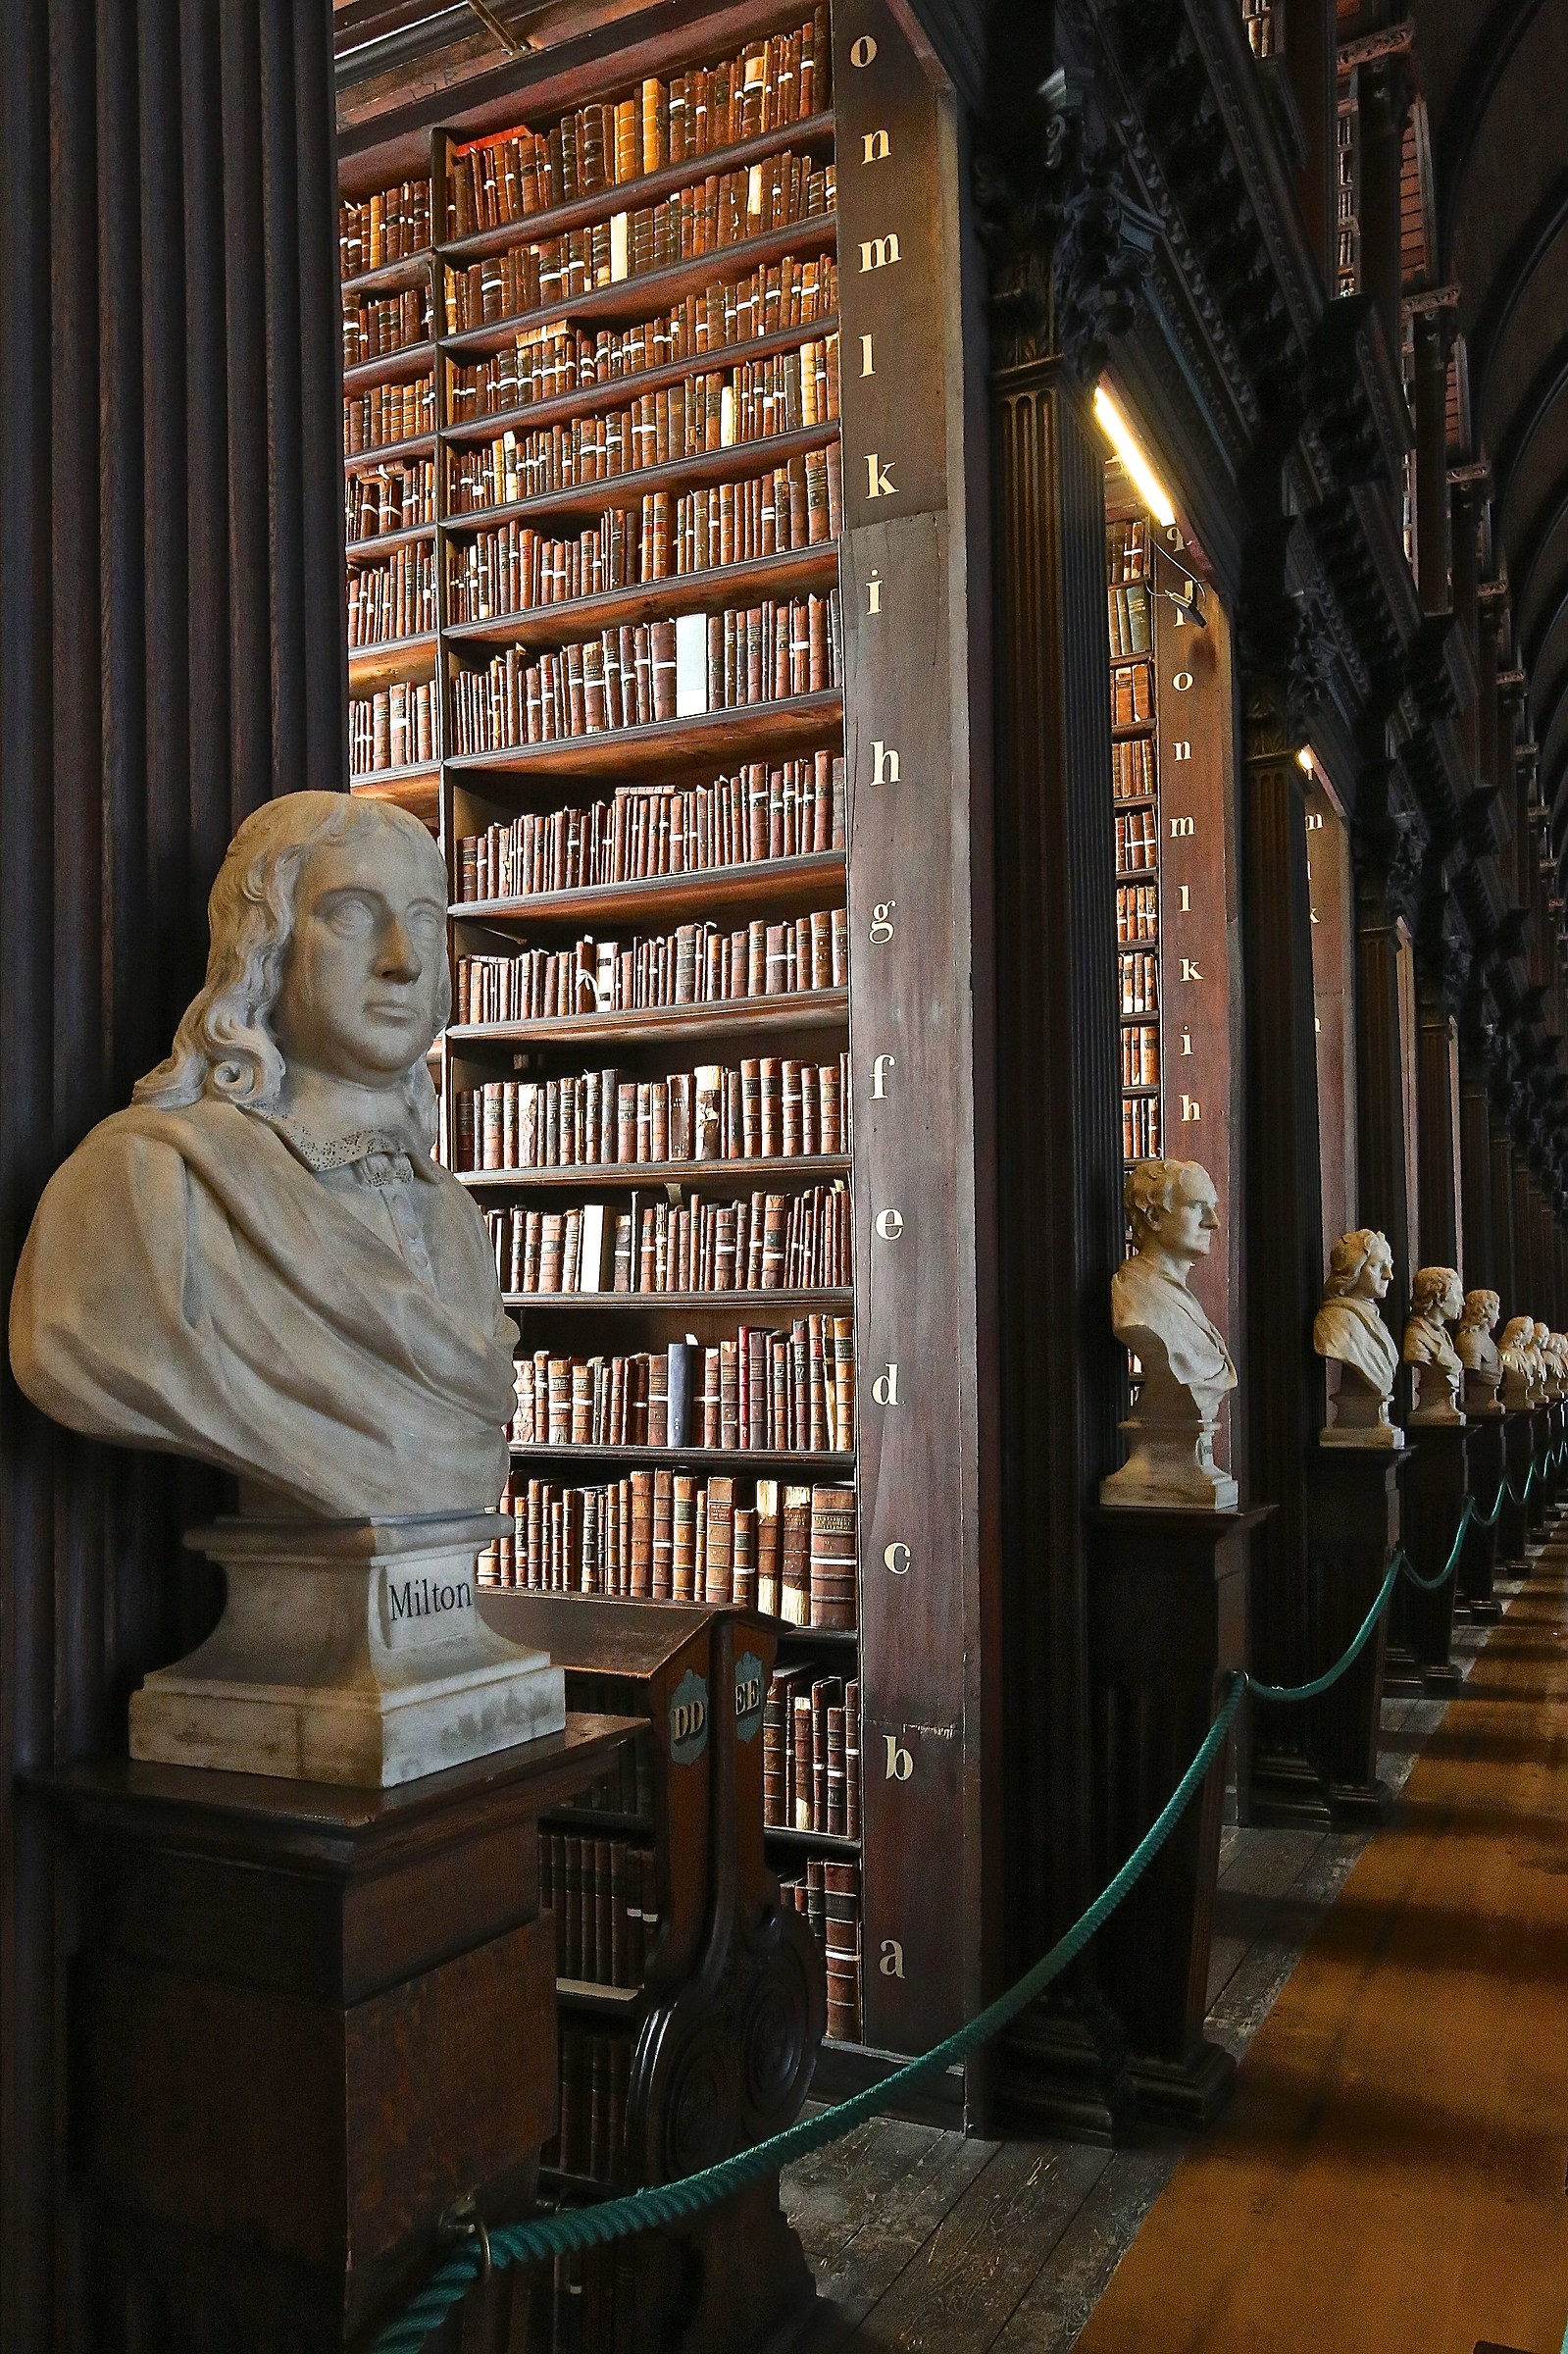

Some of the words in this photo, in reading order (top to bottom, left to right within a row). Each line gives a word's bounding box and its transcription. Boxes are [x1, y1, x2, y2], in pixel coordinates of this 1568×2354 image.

[850, 35, 878, 68] o
[861, 129, 892, 165] n
[857, 233, 902, 274] m
[863, 453, 900, 499] k
[865, 569, 884, 615] i
[1172, 672, 1193, 691] o
[869, 741, 901, 787] h
[1172, 741, 1192, 761] n
[1169, 816, 1195, 838] m
[869, 899, 896, 945] g
[1179, 958, 1204, 982] k
[1180, 1026, 1194, 1056] i
[869, 1053, 896, 1100] f
[1179, 1094, 1201, 1122] h
[875, 1207, 904, 1241] e
[872, 1362, 899, 1406] d
[884, 1542, 911, 1575] c
[388, 1578, 474, 1621] Milton
[734, 1678, 760, 1715] EE
[673, 1700, 704, 1739] DD
[882, 1734, 914, 1781] b
[879, 1939, 906, 1979] a
